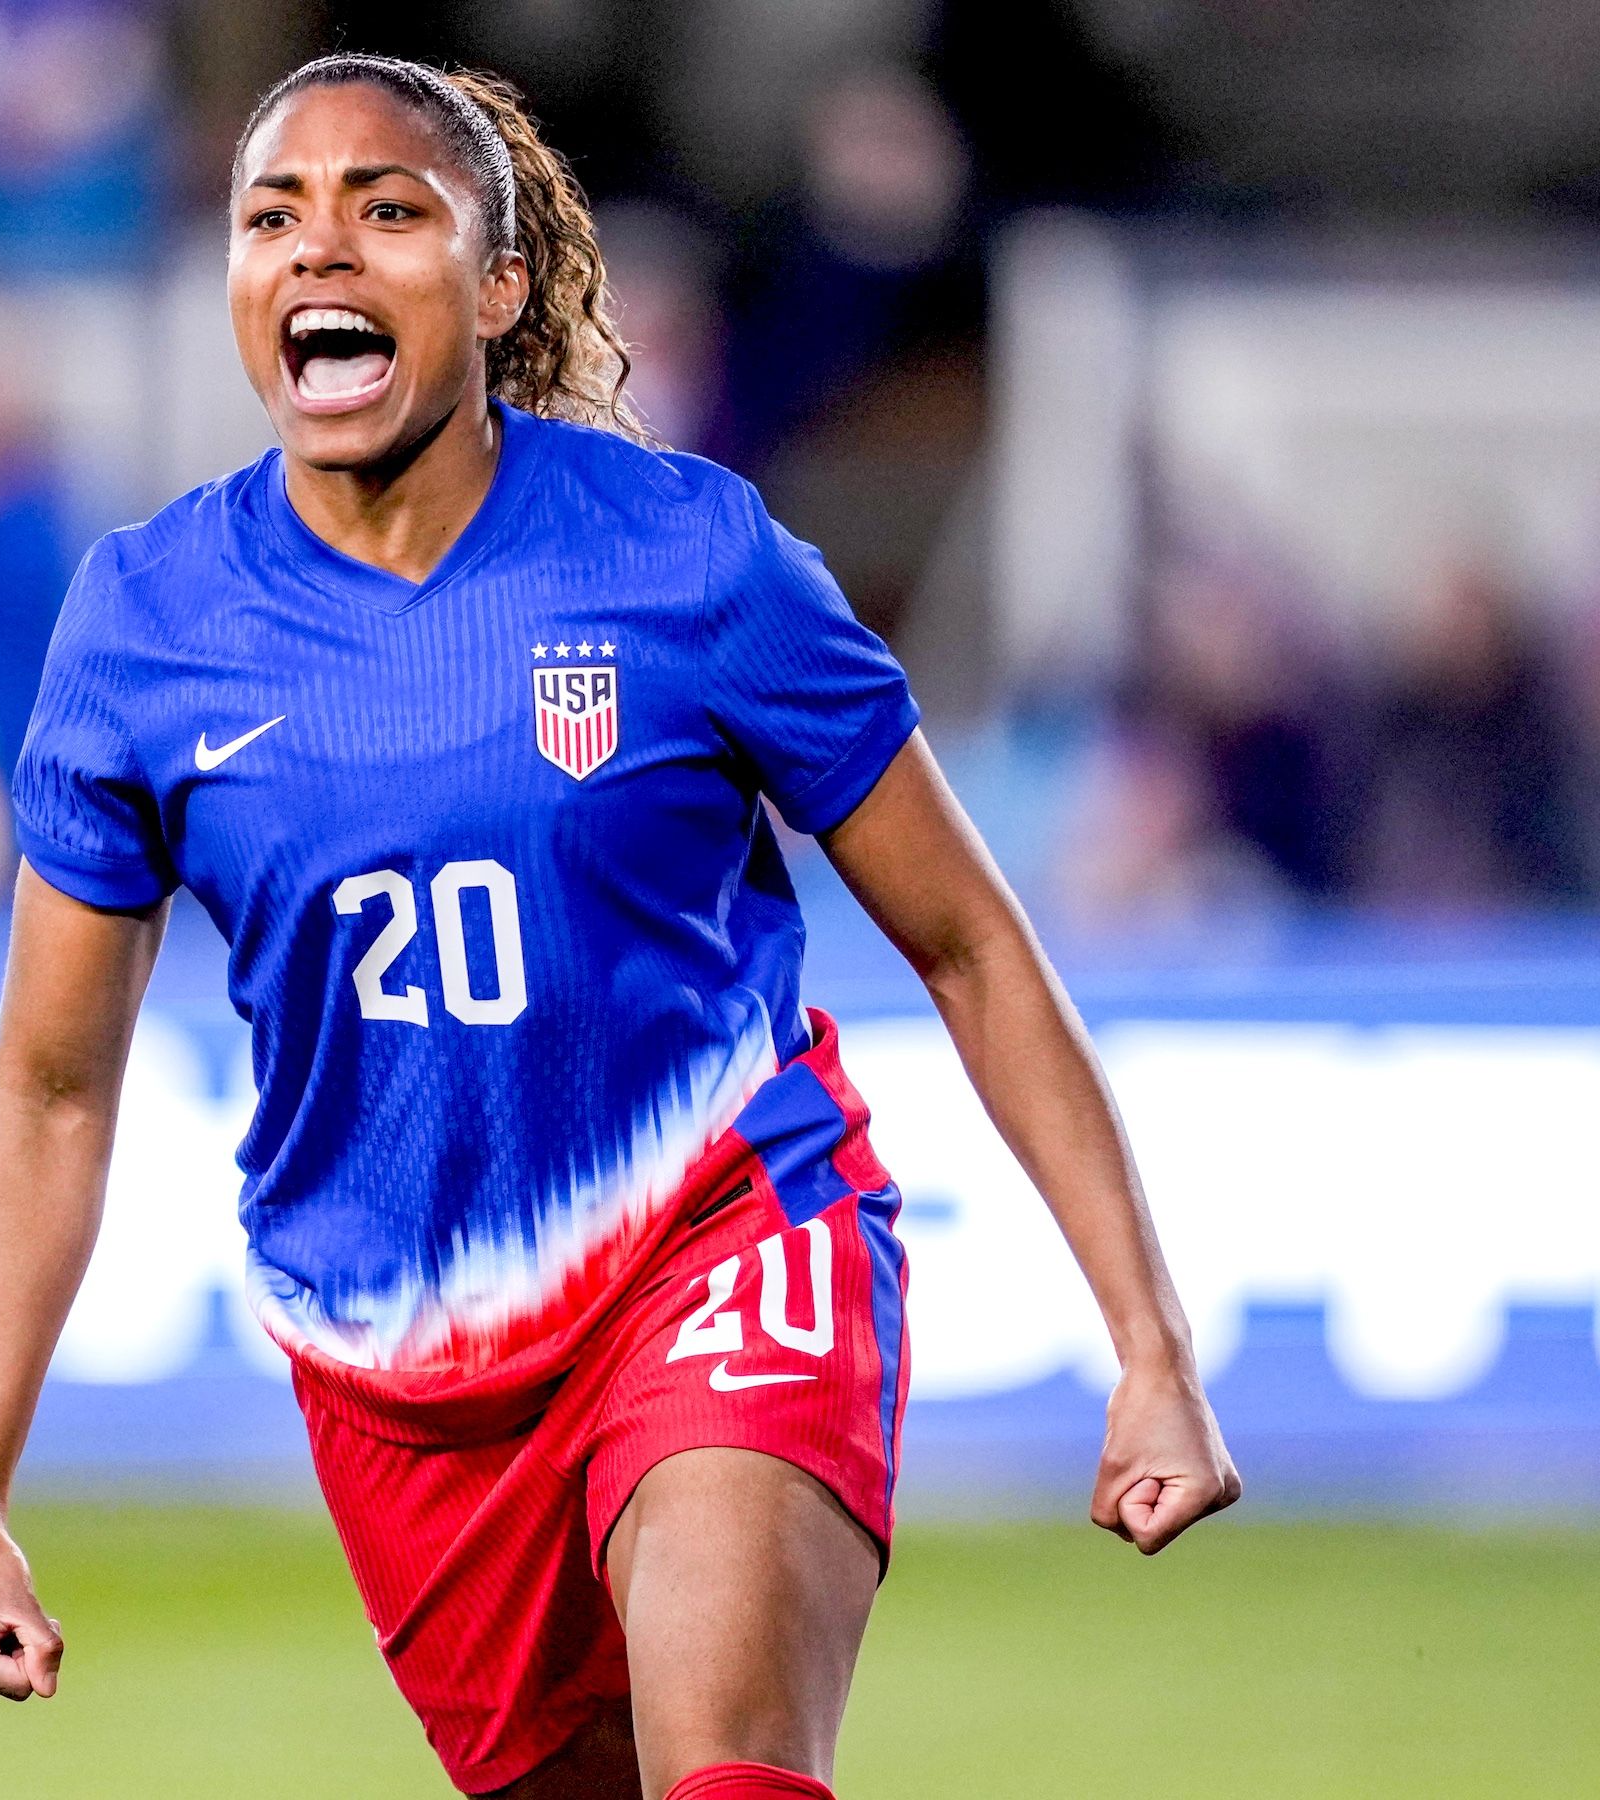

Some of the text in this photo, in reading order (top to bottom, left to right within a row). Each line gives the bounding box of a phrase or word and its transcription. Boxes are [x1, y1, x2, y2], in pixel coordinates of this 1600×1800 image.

[539, 673, 611, 714] USA
[332, 859, 528, 1028] 20
[665, 1217, 835, 1364] 20
